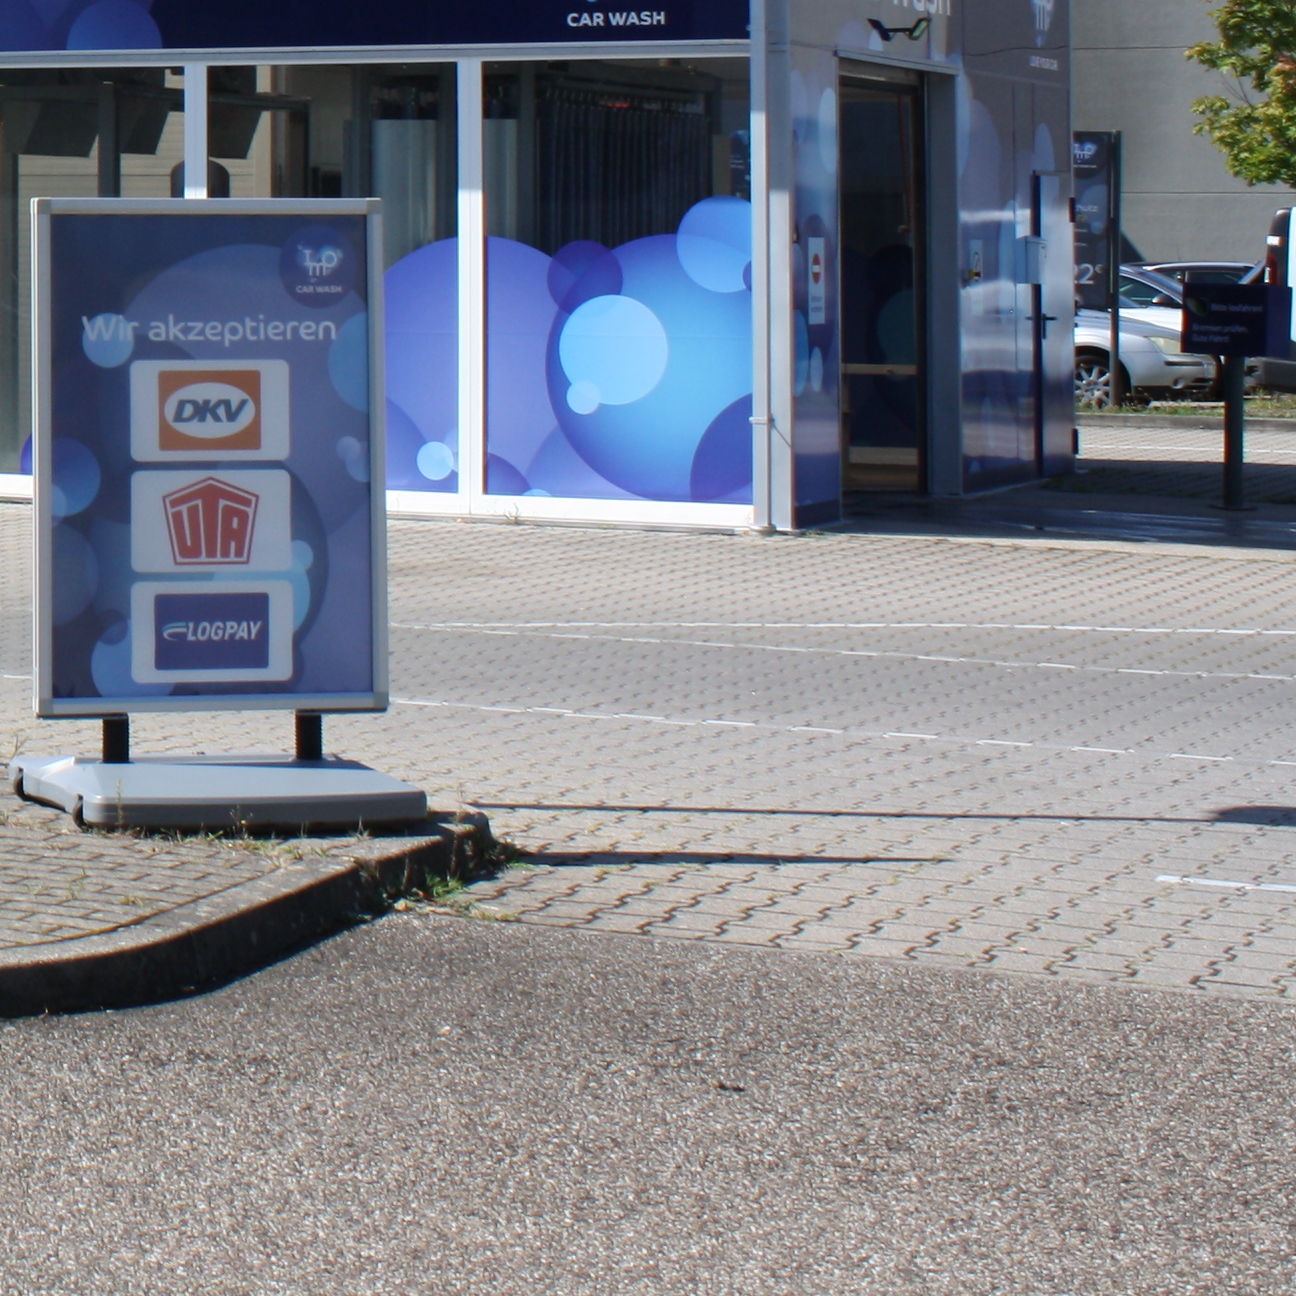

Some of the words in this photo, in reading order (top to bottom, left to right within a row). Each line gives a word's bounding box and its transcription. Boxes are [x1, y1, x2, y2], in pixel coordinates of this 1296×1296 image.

[566, 12, 605, 28] CAR
[607, 11, 666, 27] WASH
[296, 285, 314, 294] CAR
[315, 285, 343, 294] WASH
[82, 314, 141, 342] Wir
[149, 314, 337, 347] akzeptieren
[172, 398, 250, 423] DKV
[165, 481, 255, 559] UTA
[186, 620, 263, 642] LOGPAY
